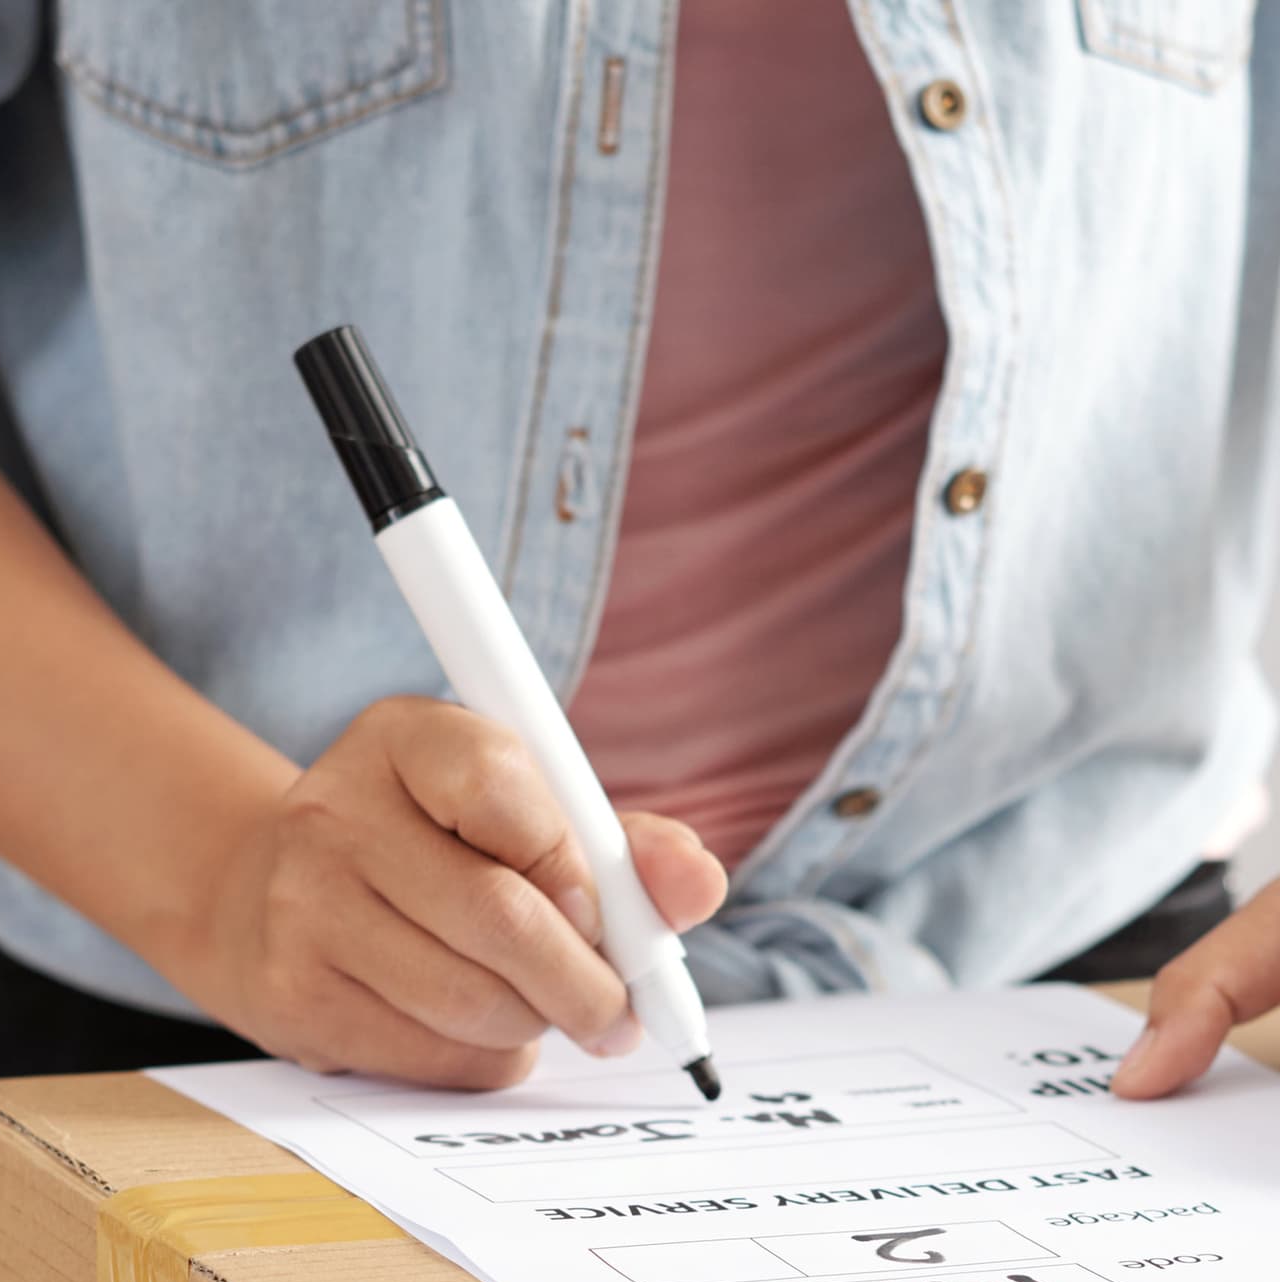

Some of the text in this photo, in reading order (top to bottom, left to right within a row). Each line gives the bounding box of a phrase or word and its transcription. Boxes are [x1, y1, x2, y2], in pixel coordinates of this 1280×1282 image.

[414, 1119, 697, 1147] James
[535, 1165, 1152, 1220] FAST DELIVERY SERVICE
[1045, 1202, 1222, 1227] package
[851, 1228, 947, 1264] 2
[1118, 1253, 1224, 1270] code
